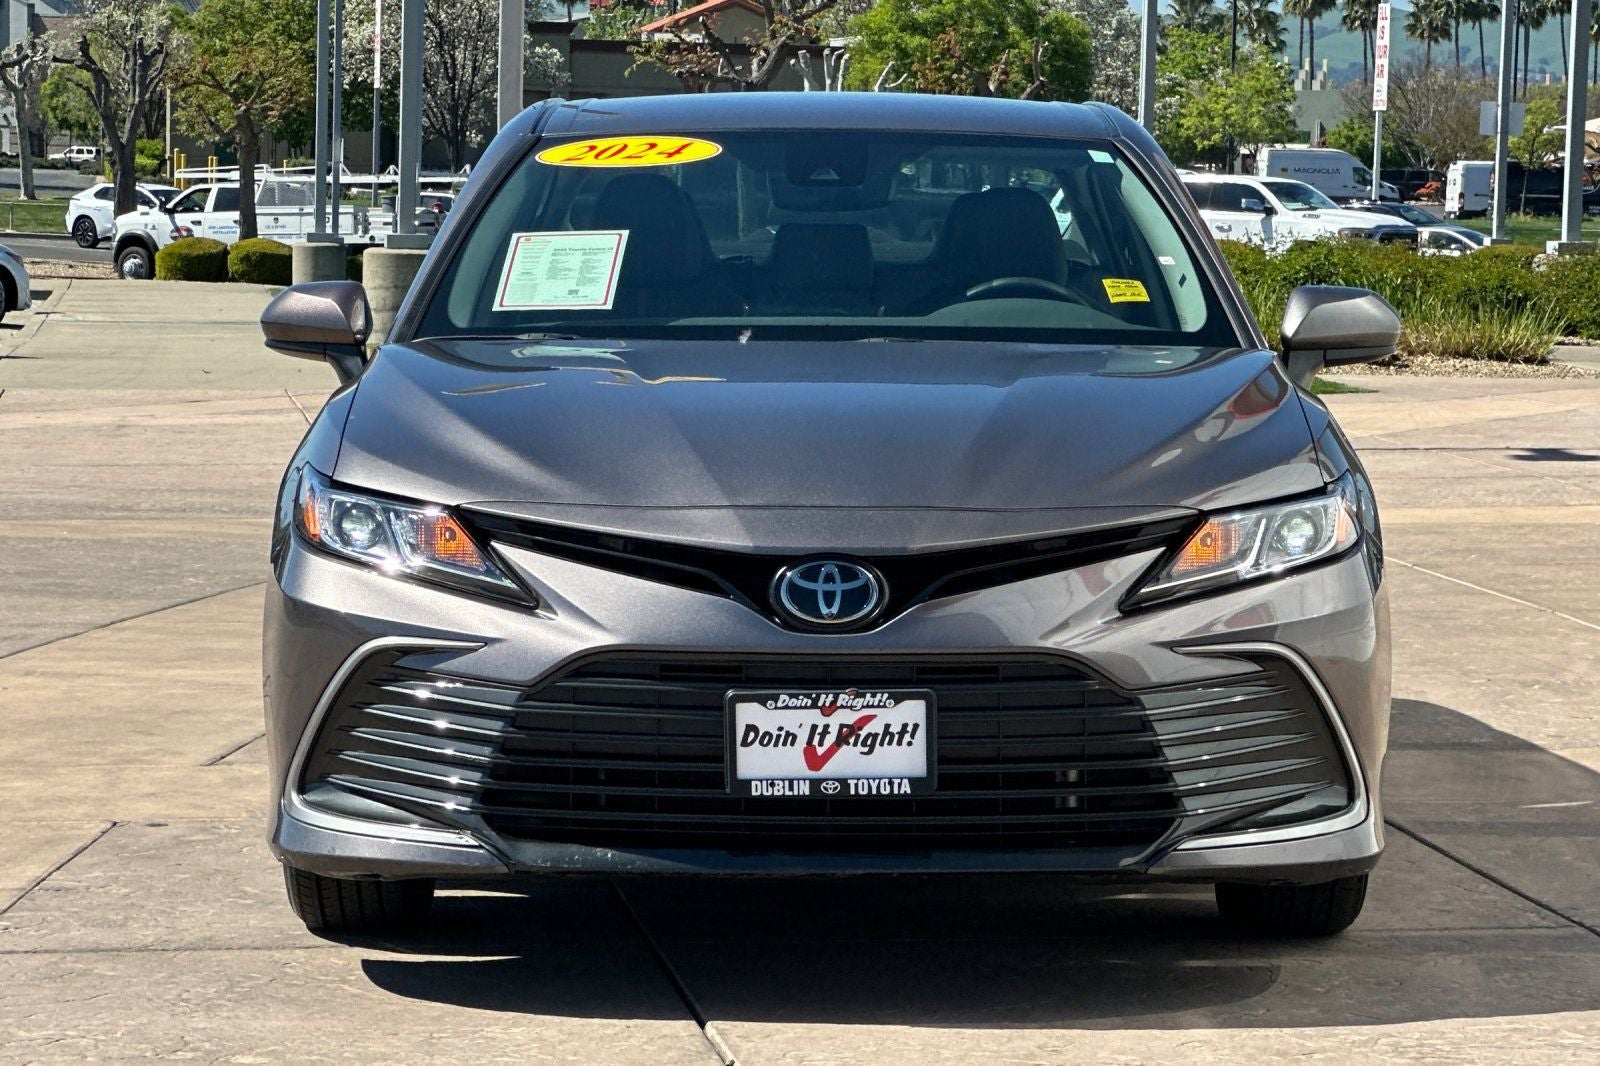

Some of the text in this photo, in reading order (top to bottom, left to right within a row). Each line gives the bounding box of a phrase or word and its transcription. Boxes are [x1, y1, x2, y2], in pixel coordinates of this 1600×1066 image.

[560, 141, 696, 162] 2024
[1293, 167, 1341, 175] MAGNOLIA
[776, 693, 889, 711] Doin' It Right!
[740, 722, 920, 756] Doin' It Right!
[751, 779, 912, 796] DUBLIN TOYOTA
